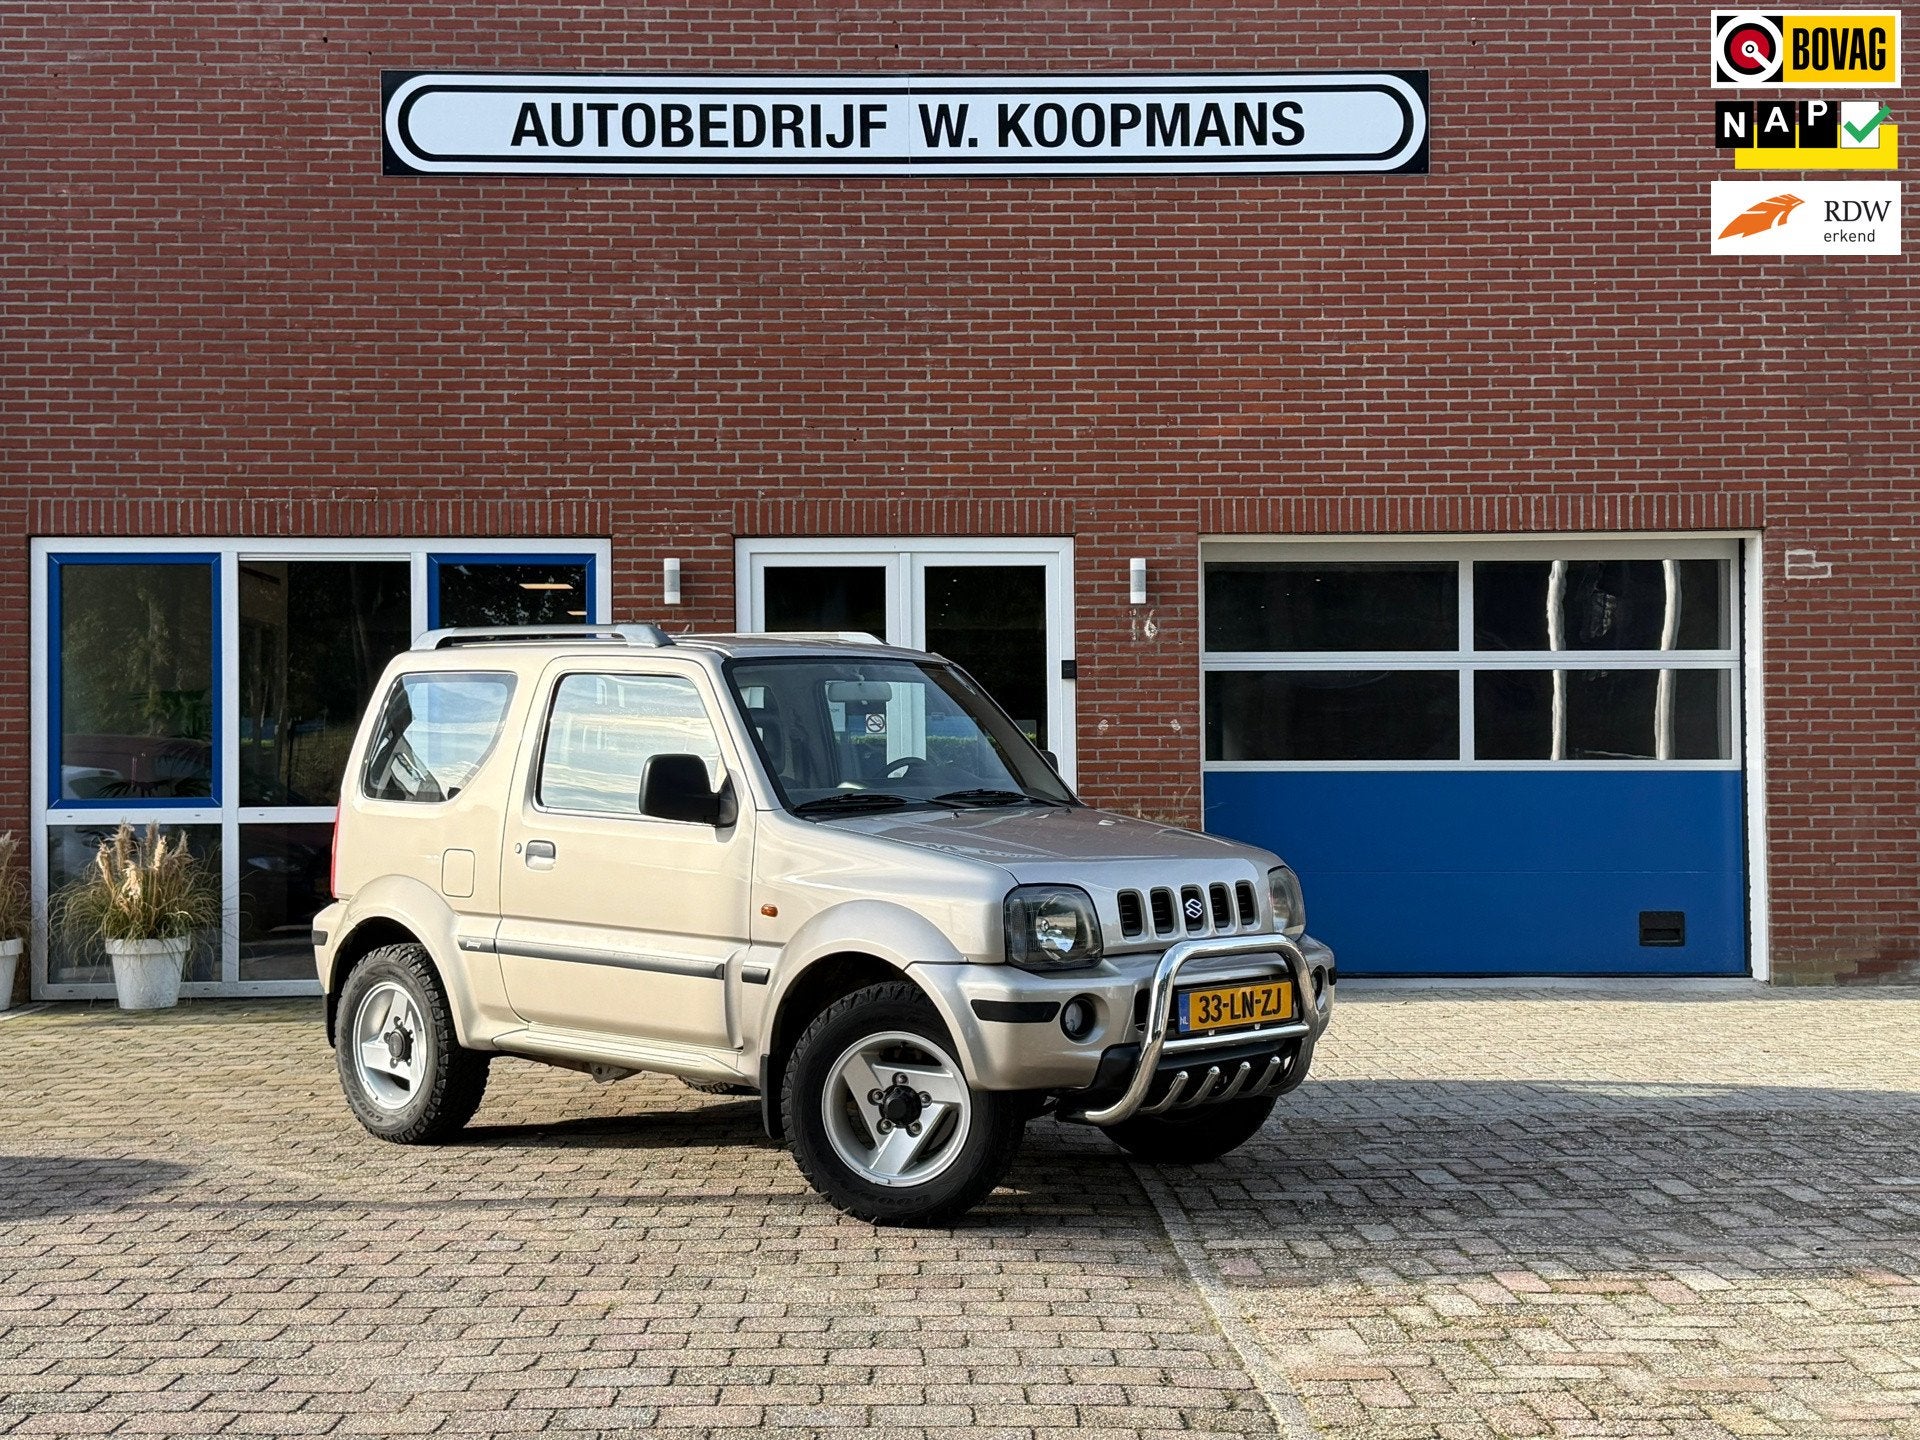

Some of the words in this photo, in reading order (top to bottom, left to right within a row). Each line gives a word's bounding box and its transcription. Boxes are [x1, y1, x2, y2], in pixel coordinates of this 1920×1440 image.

[510, 102, 888, 149] AUTOBEDRIJF
[918, 103, 978, 148] W.
[998, 101, 1305, 148] KOOPMANS
[1198, 987, 1282, 1024] 33-LN-ZJ
